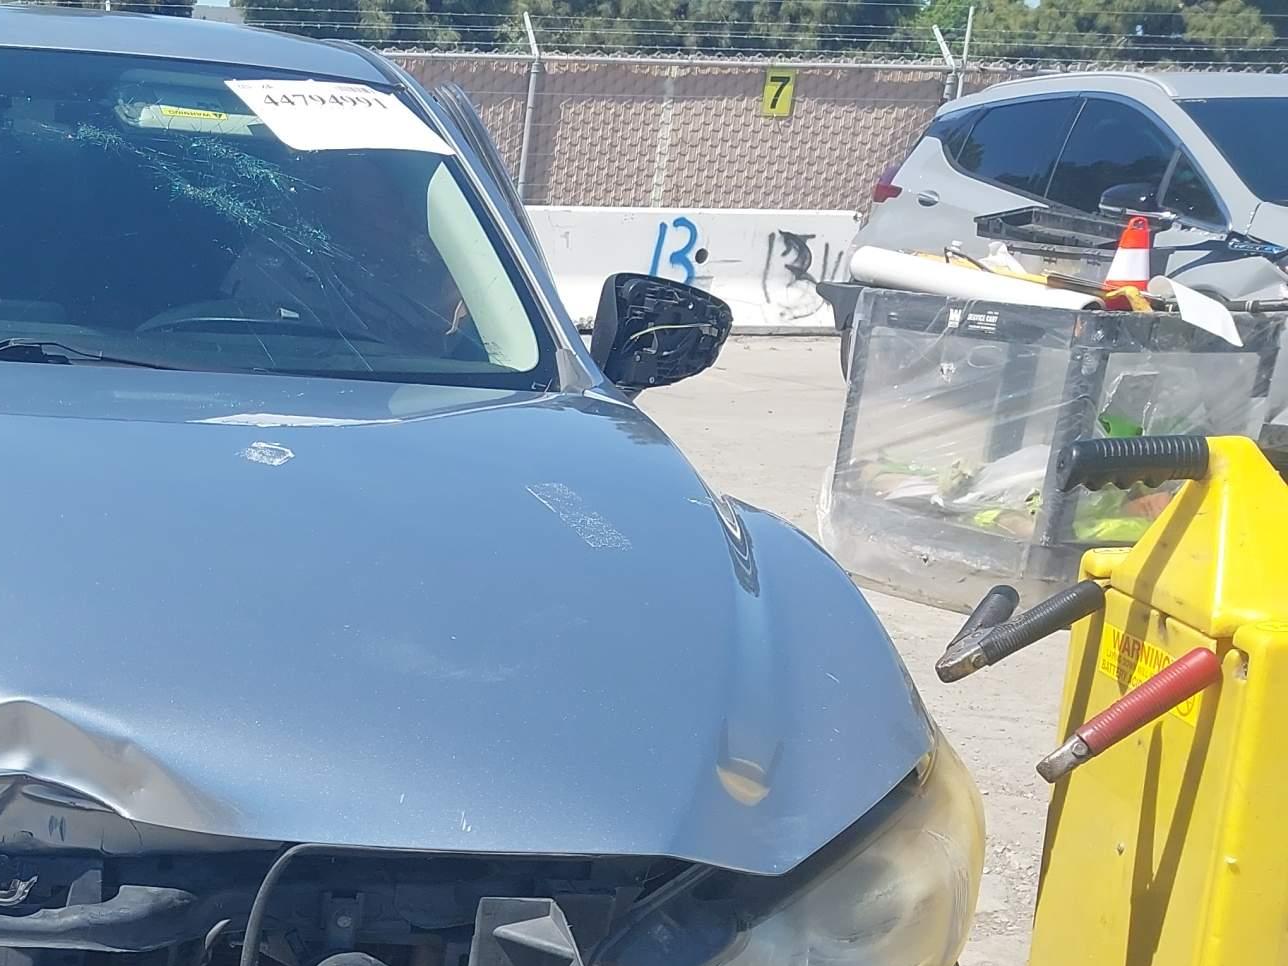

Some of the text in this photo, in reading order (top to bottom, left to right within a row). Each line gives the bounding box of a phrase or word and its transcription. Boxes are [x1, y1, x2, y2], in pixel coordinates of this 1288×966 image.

[263, 94, 388, 109] 44794991
[770, 76, 791, 109] 7
[649, 217, 698, 284] 13
